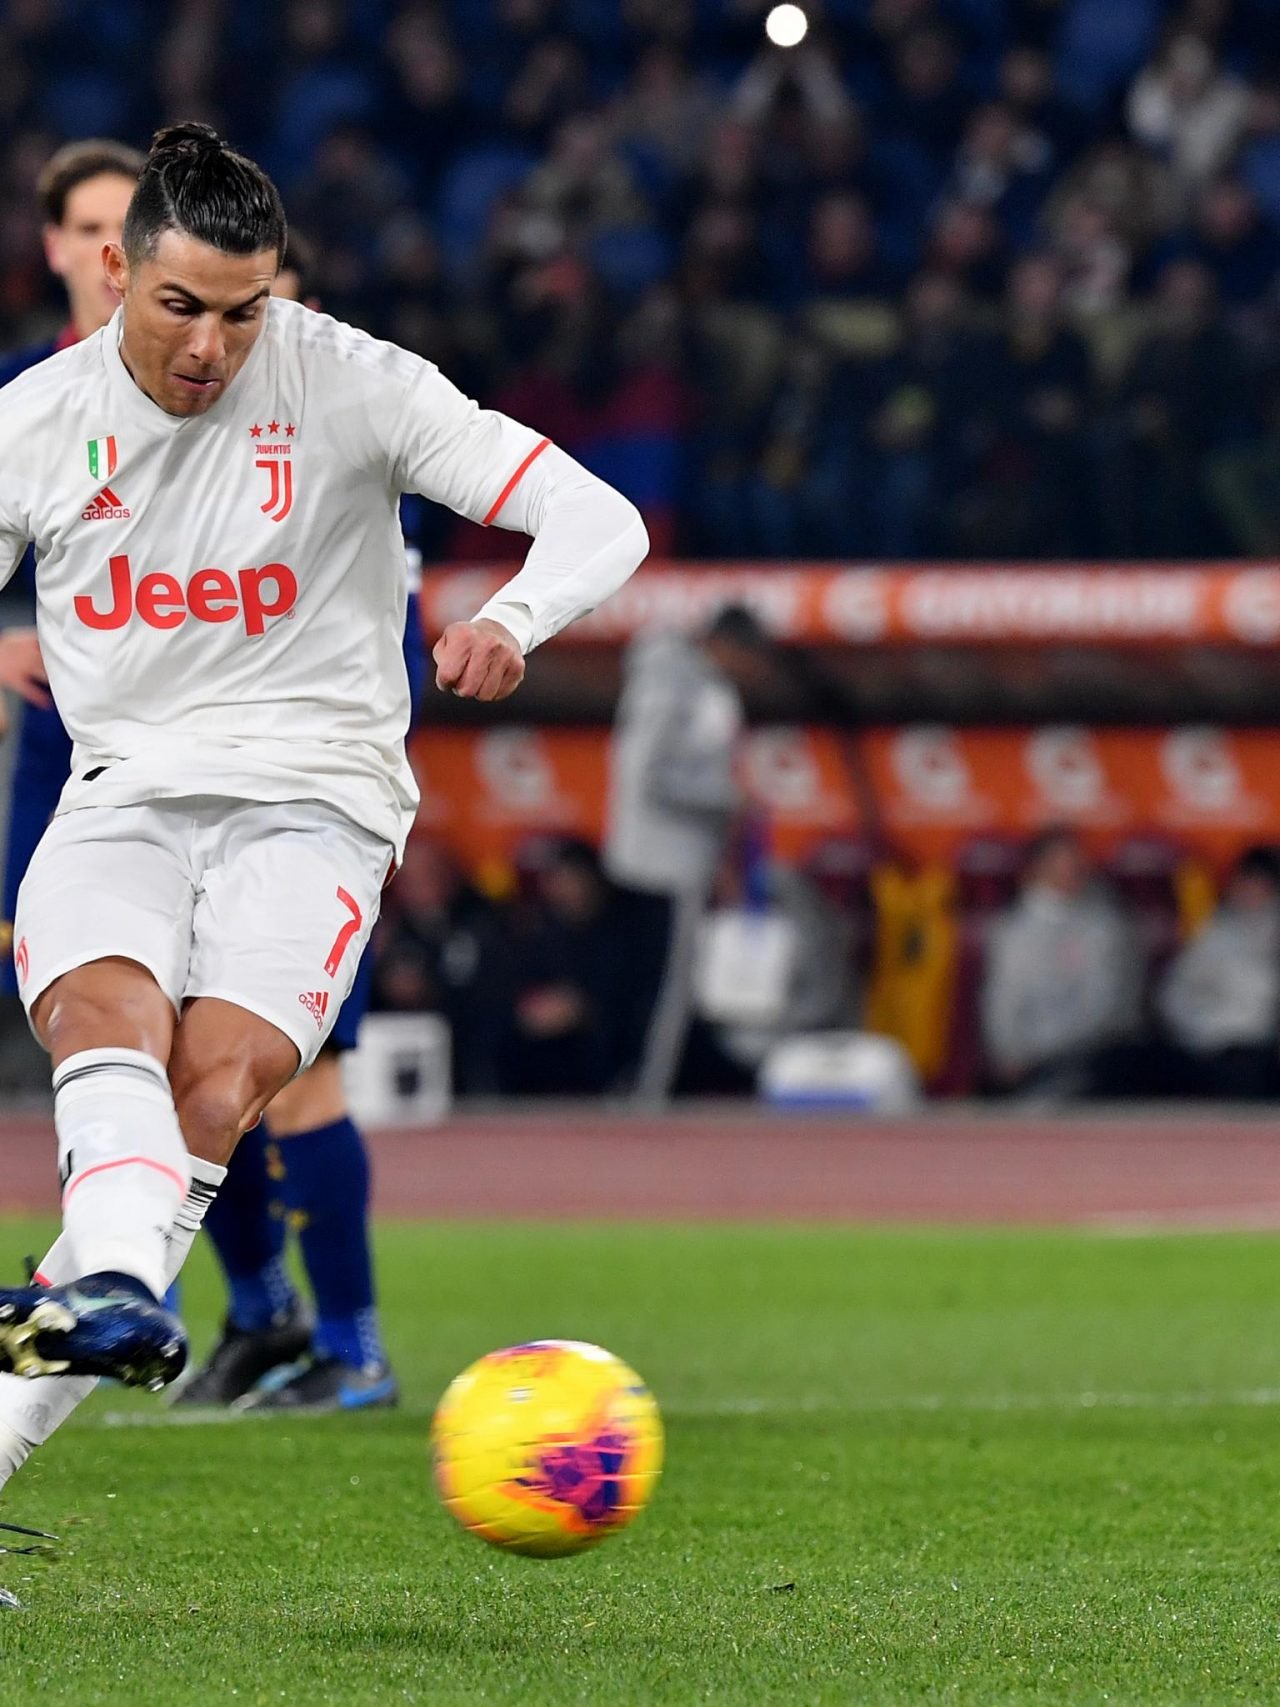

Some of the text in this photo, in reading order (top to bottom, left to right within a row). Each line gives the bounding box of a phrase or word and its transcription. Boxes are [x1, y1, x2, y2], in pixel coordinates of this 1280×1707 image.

[256, 444, 291, 455] JUVENTUS
[81, 507, 130, 520] adidas
[73, 555, 298, 636] Jeep
[324, 886, 362, 978] 7
